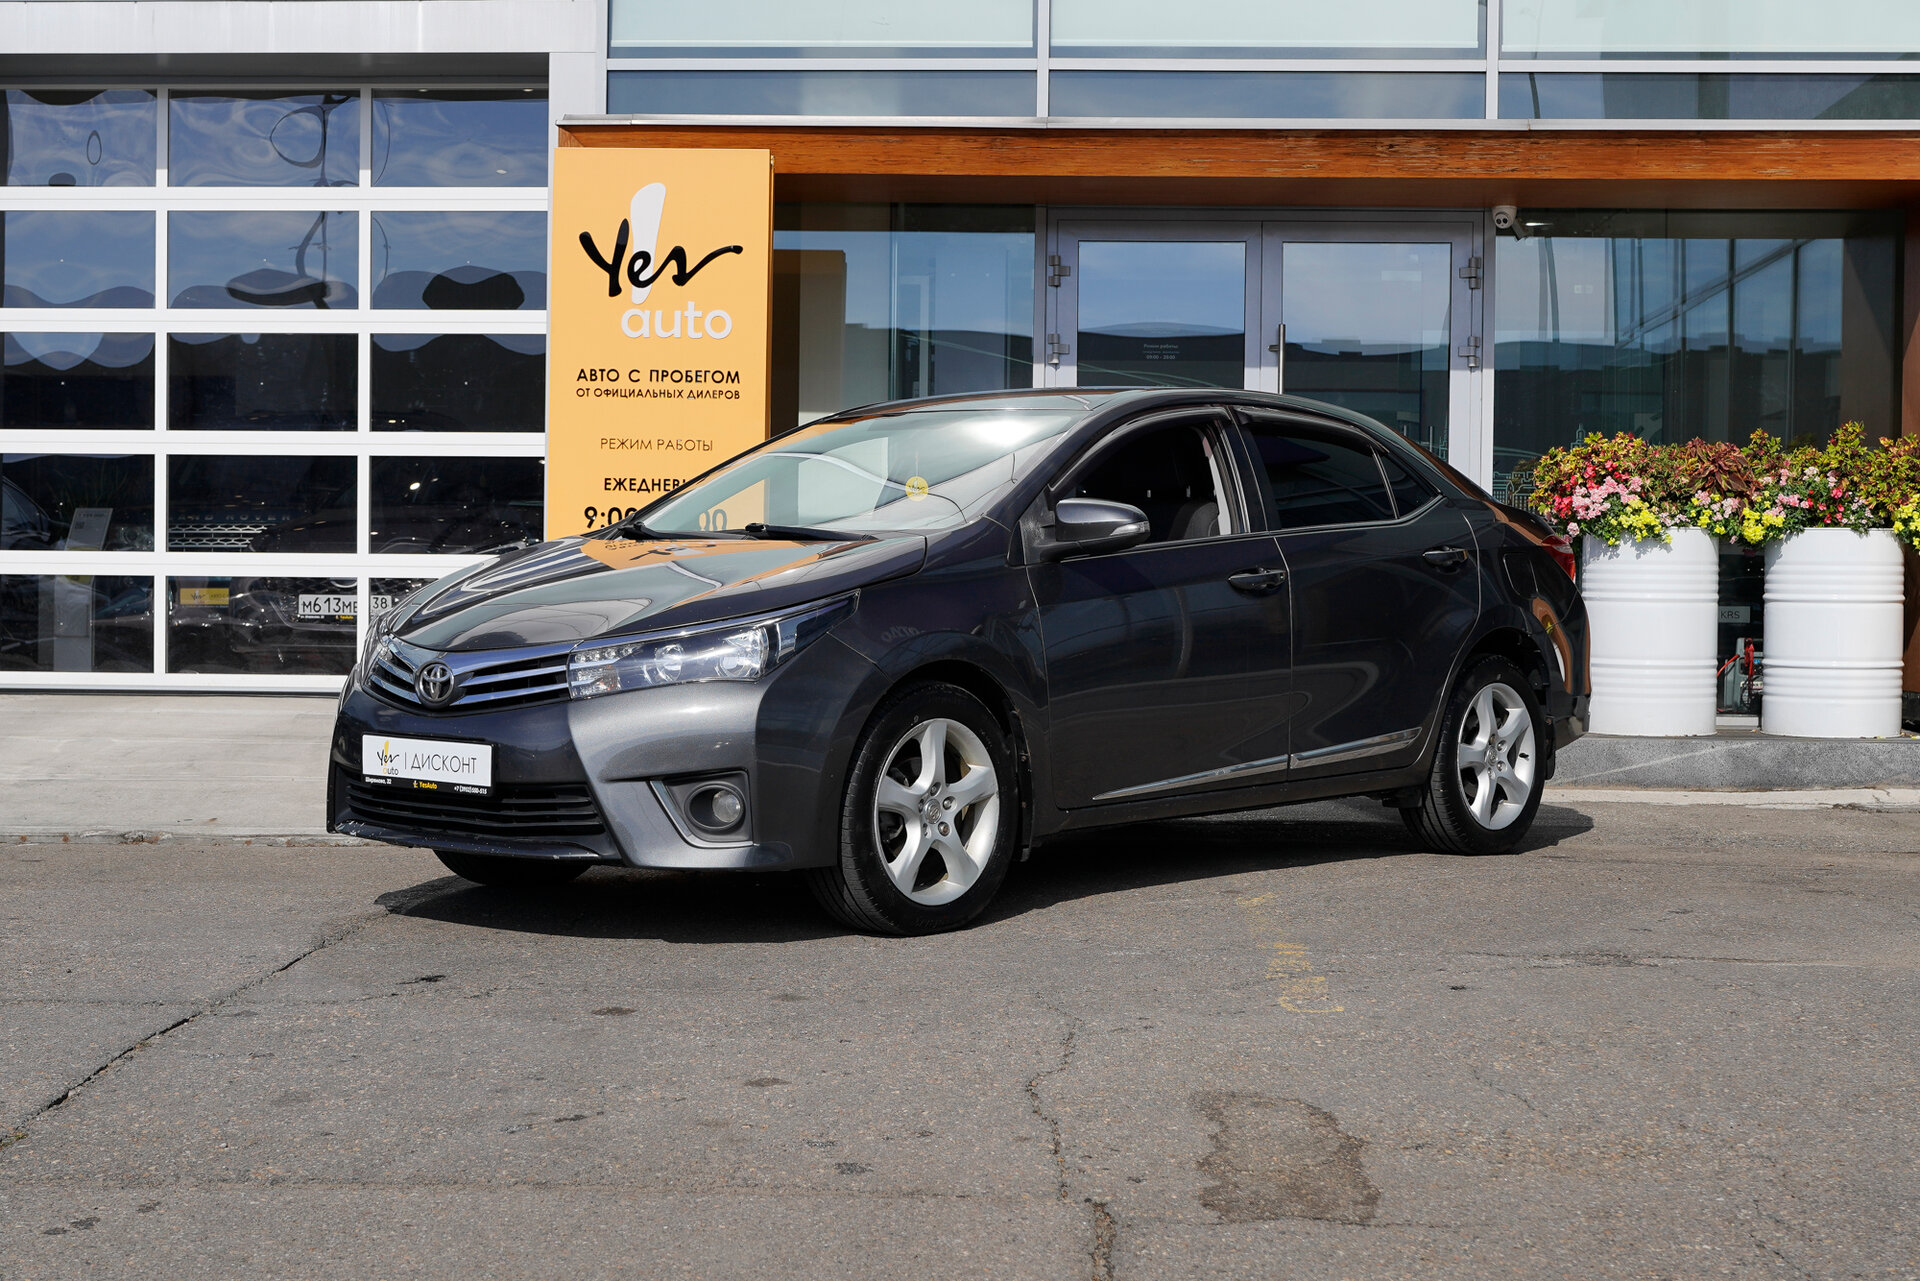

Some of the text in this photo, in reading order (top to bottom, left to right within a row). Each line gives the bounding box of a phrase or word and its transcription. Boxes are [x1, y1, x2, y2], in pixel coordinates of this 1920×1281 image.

[579, 218, 743, 297] Yes
[621, 301, 733, 339] auto
[576, 368, 741, 384] АВТО С ПРОБЕГОМ
[576, 387, 741, 400] ОТ ОФИЦИАЛЬНЫХ ДИЛЕРОВ
[600, 438, 713, 452] РЕЖИМ РАБОТЫ
[604, 477, 686, 493] ЕЖЕДНЕВ
[372, 597, 388, 609] 38
[1720, 610, 1740, 619] KRS
[411, 751, 477, 774] ДИСКОНТ
[382, 767, 399, 776] auto
[419, 781, 438, 790] YesAuto
